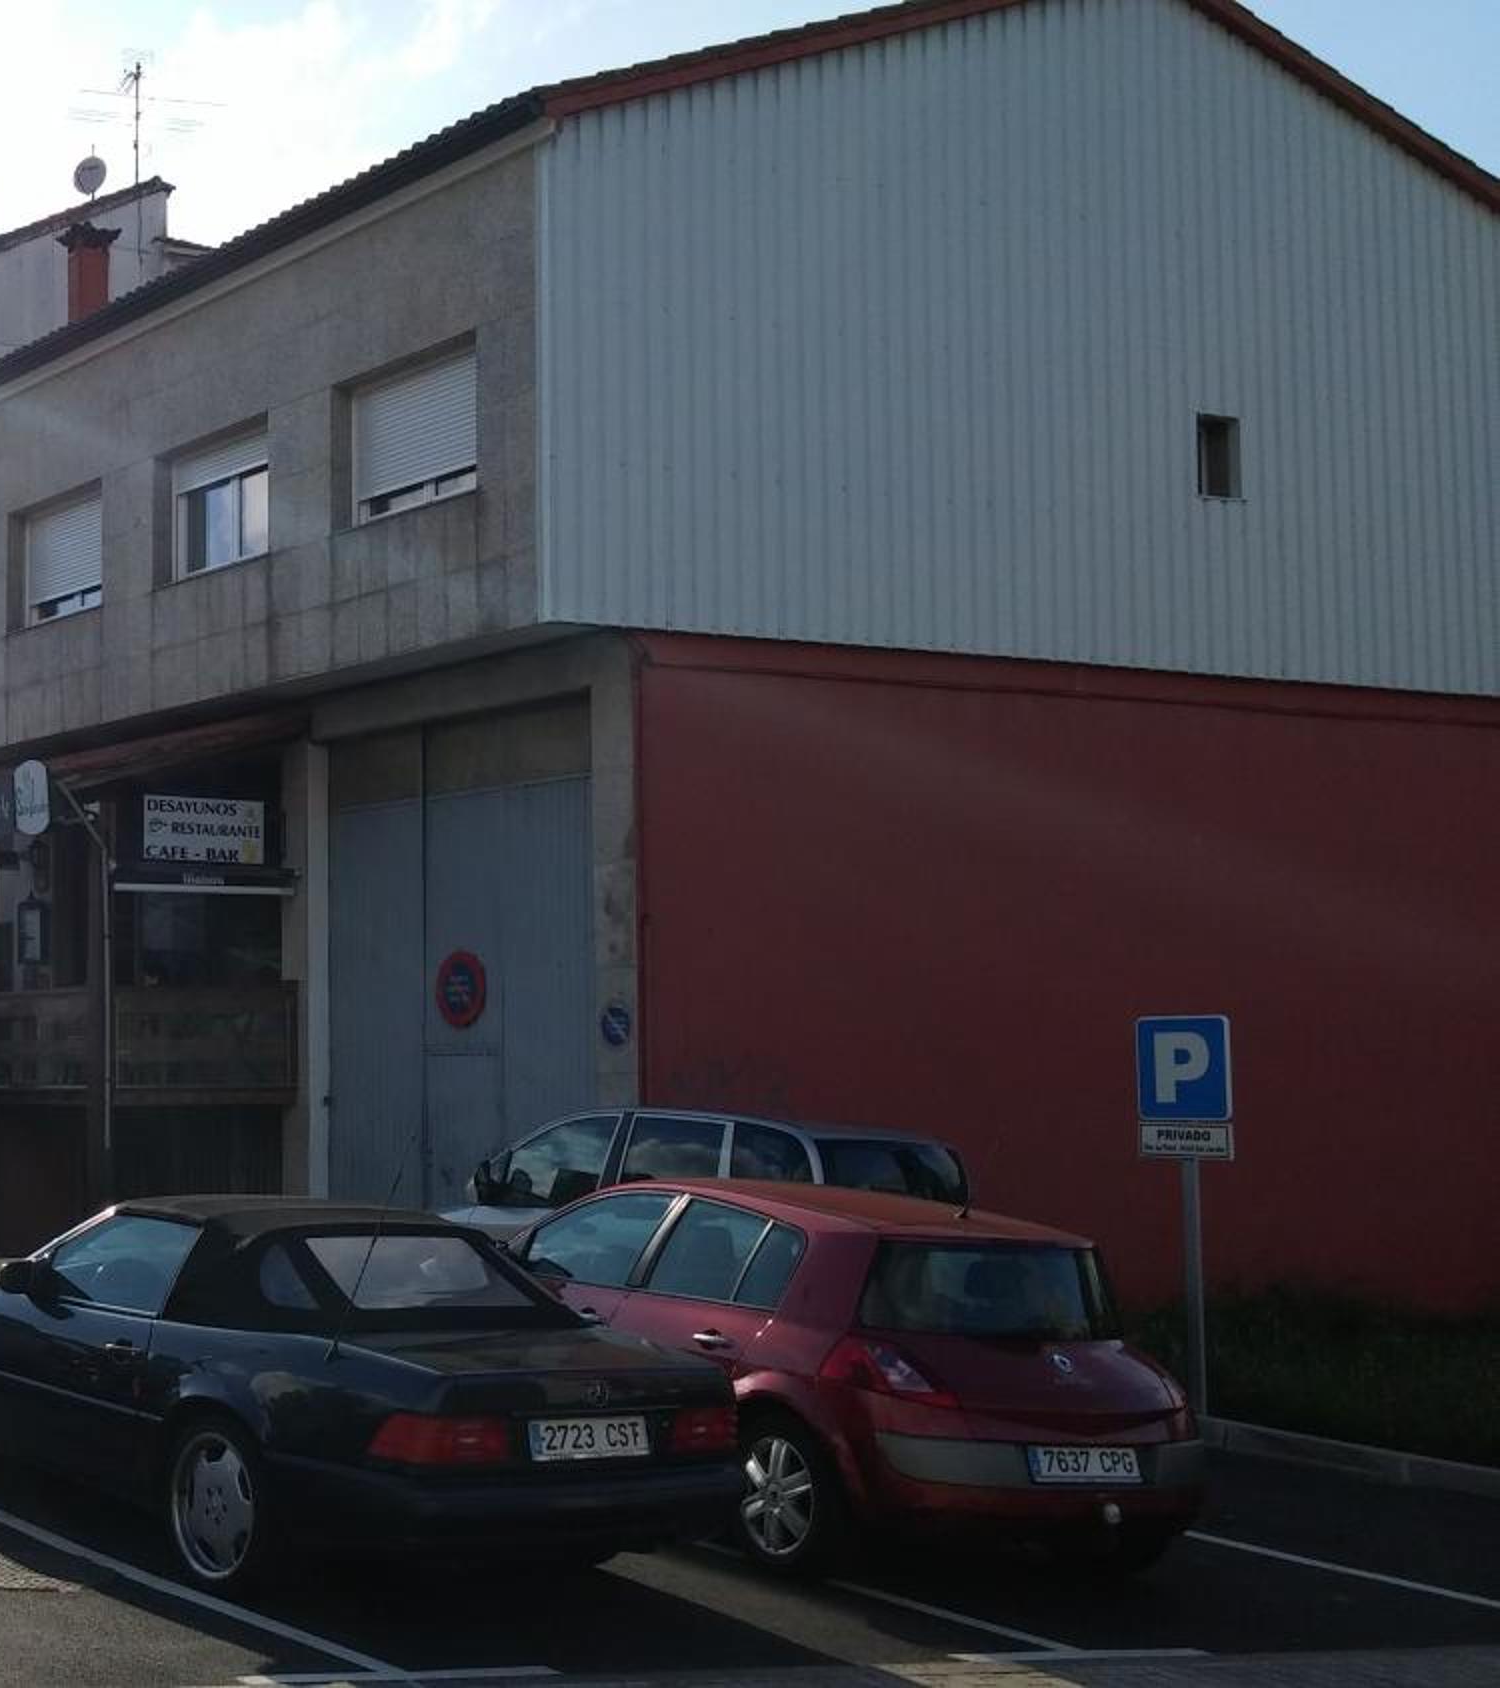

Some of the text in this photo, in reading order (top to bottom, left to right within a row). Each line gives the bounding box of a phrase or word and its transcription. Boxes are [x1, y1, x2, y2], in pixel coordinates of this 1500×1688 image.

[147, 799, 238, 816] DESAYUNOS
[171, 821, 260, 839] RESTAURANTE
[206, 847, 239, 862] BAR
[1153, 1031, 1210, 1104] P
[1156, 1129, 1211, 1142] PRIVADO
[544, 1423, 596, 1452] 2723
[1043, 1451, 1133, 1473] 7637 CPG
